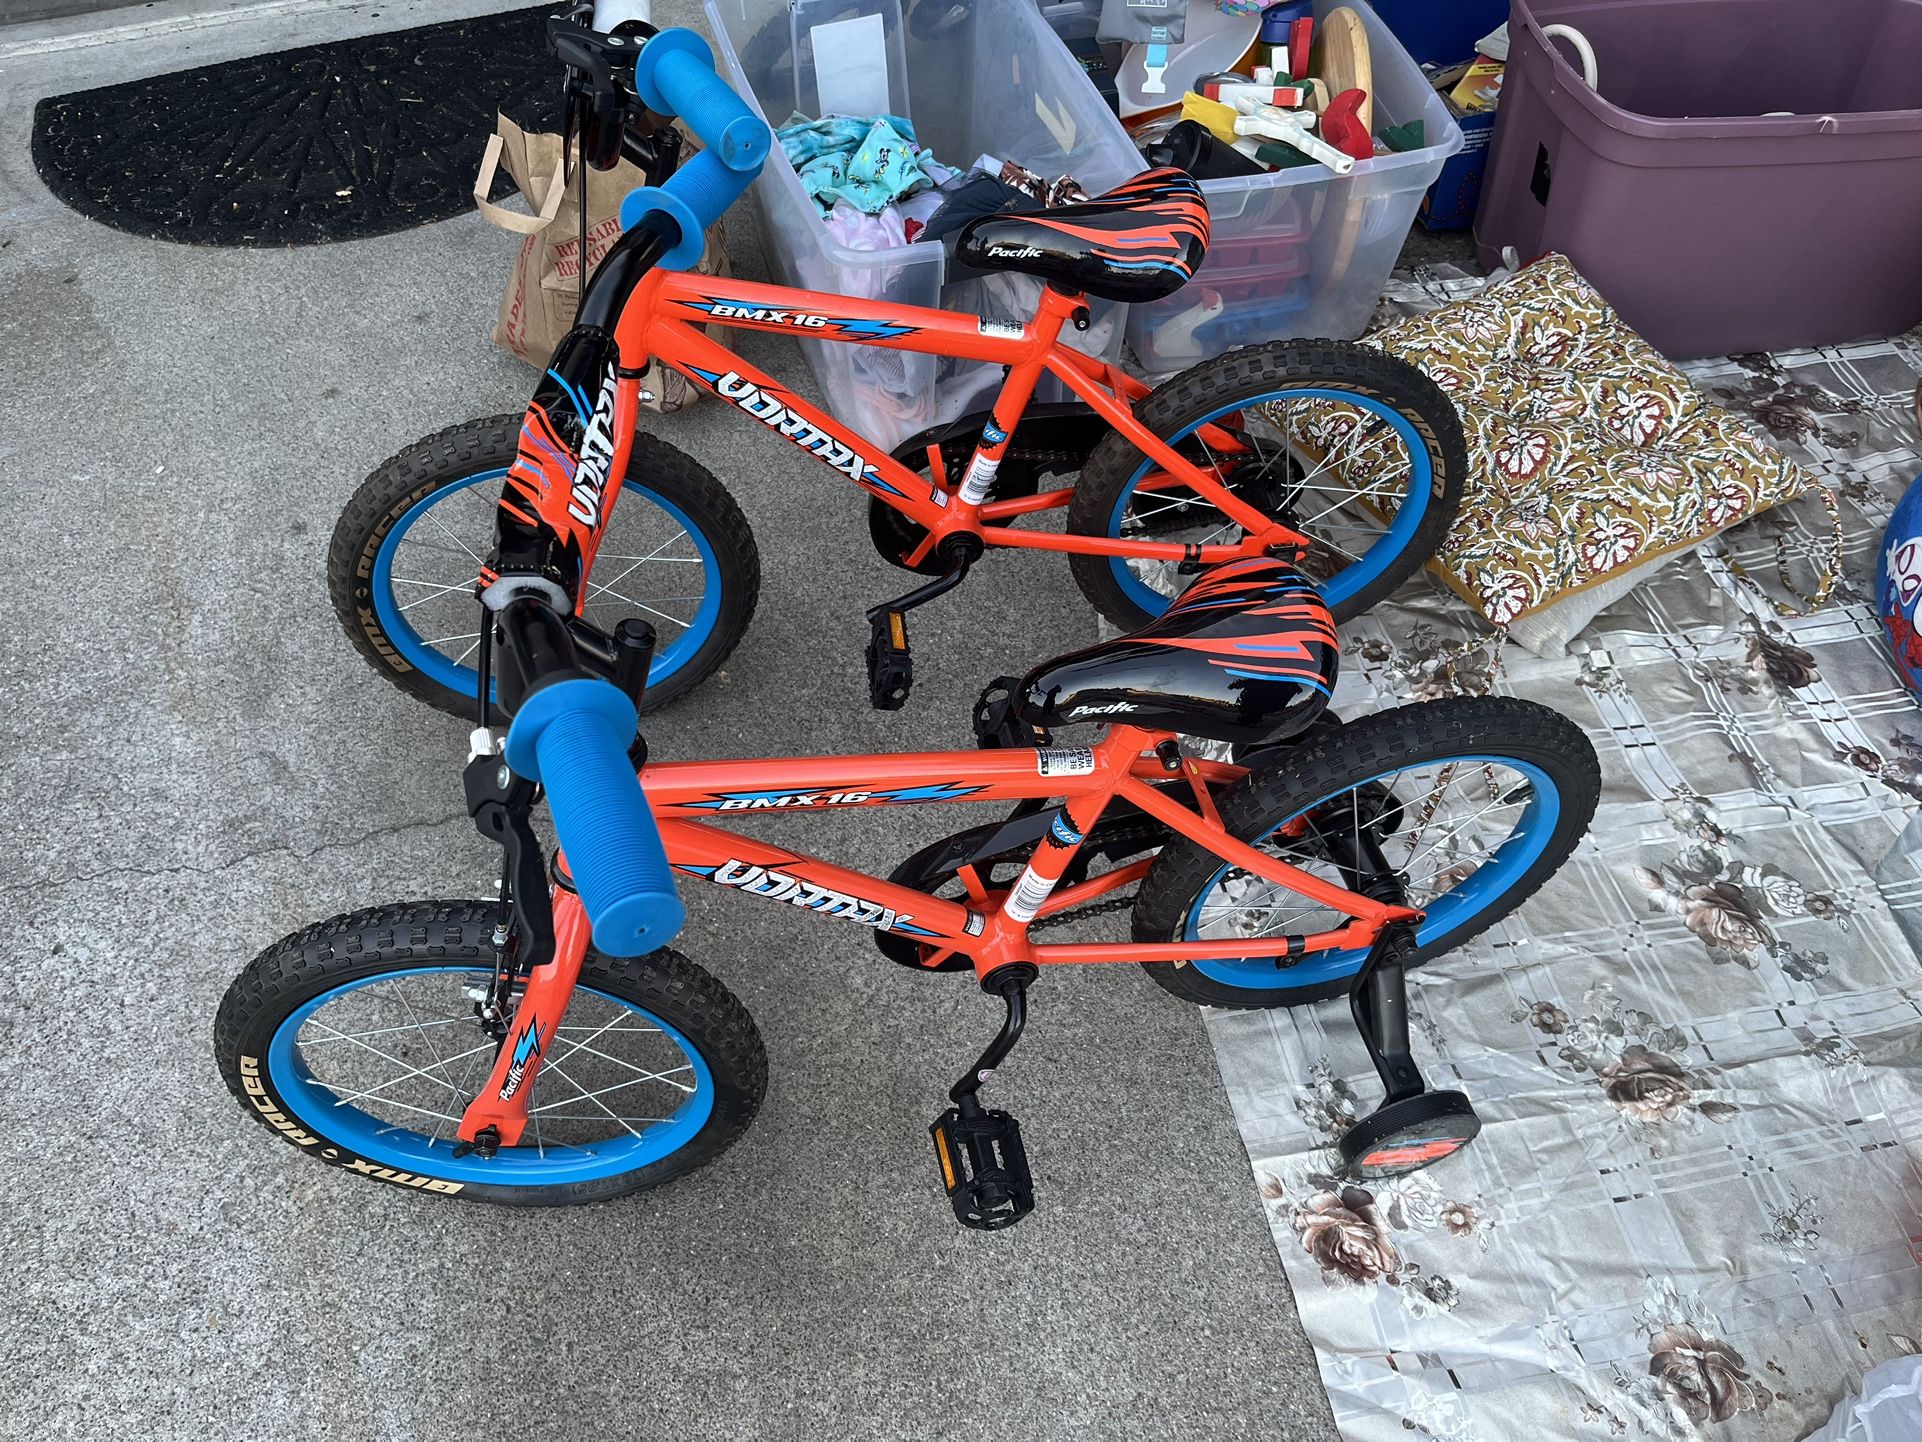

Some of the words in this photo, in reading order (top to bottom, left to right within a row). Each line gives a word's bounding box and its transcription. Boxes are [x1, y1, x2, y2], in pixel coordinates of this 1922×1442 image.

[987, 246, 1043, 259] Pacific
[710, 304, 790, 324] BMX
[793, 314, 829, 328] 16
[718, 371, 880, 481] VORTAX
[1397, 407, 1447, 500] RACER
[356, 480, 438, 579] RACER
[356, 606, 414, 673] BMX
[1067, 701, 1139, 718] Pacific
[719, 794, 824, 811] BMX
[826, 791, 873, 804] 16
[714, 858, 915, 931] VORTAX
[240, 1055, 320, 1146] RACER
[499, 1064, 525, 1102] Pacific
[341, 1159, 465, 1195] BMX
